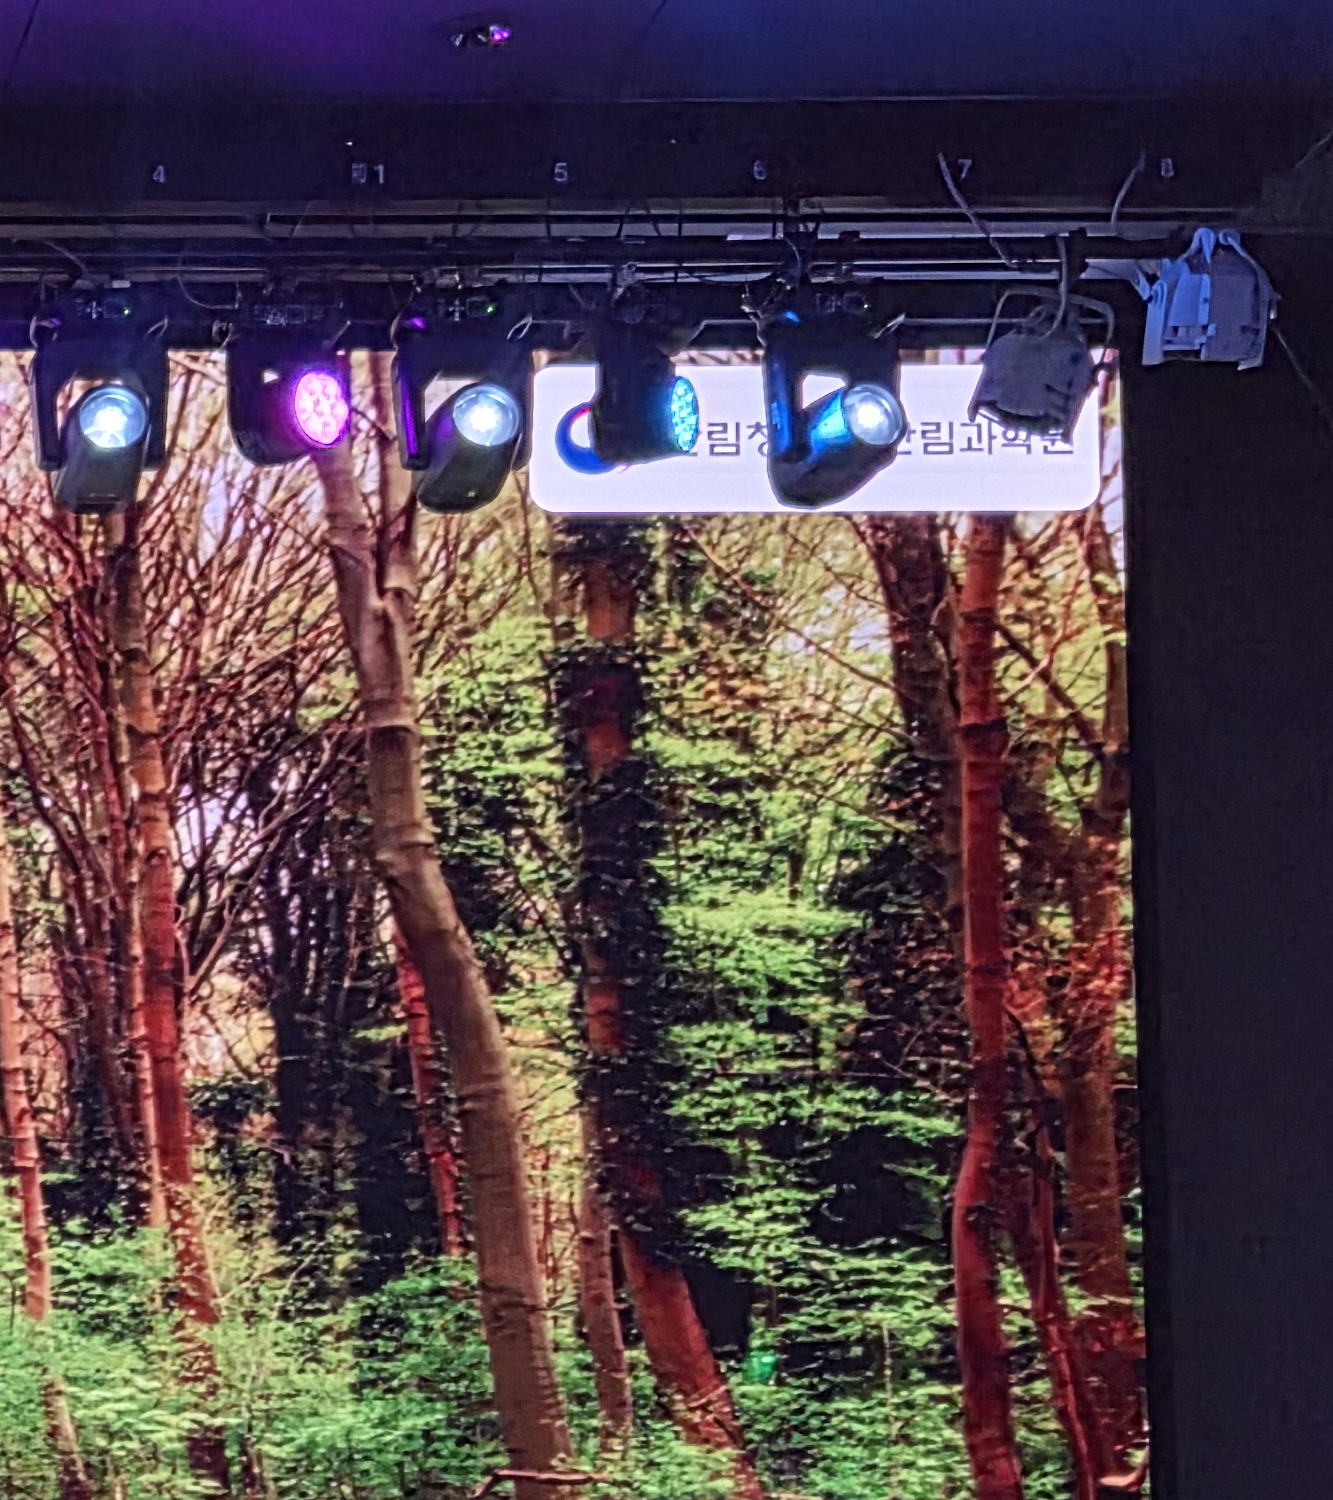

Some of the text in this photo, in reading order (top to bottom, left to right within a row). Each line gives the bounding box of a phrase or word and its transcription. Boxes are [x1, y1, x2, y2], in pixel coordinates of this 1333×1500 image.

[152, 165, 167, 184] 4
[554, 162, 569, 183] 5
[753, 160, 768, 181] 6
[957, 158, 973, 180] 7
